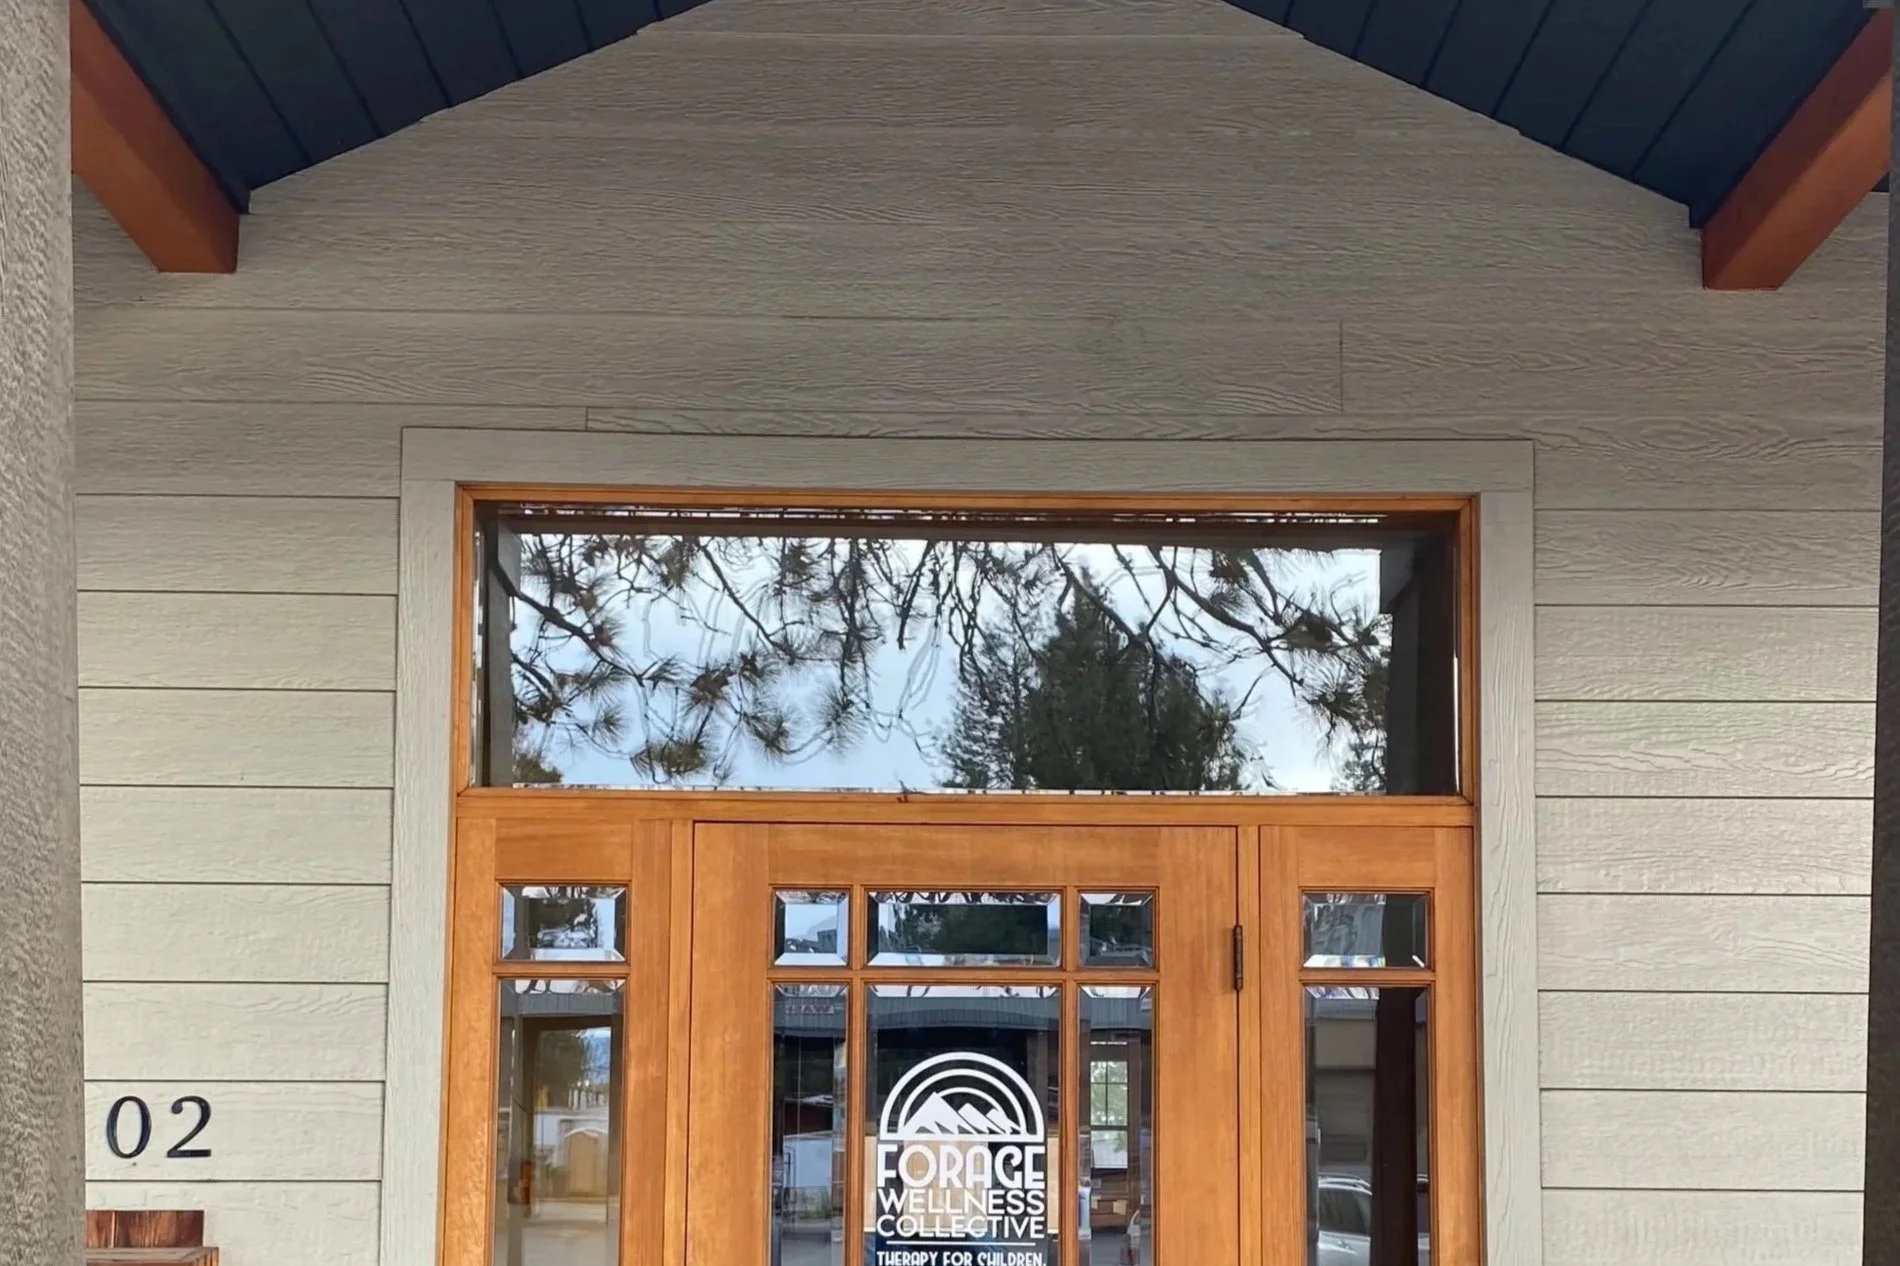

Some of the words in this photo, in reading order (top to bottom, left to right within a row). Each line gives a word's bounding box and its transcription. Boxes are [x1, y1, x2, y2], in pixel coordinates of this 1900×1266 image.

[877, 1145, 1045, 1188] FORAGE
[878, 1189, 1045, 1215] WELLNESS
[877, 1214, 1045, 1238] COLLECTIVE
[877, 1251, 938, 1266] THERAPY
[943, 1252, 973, 1266] FOR
